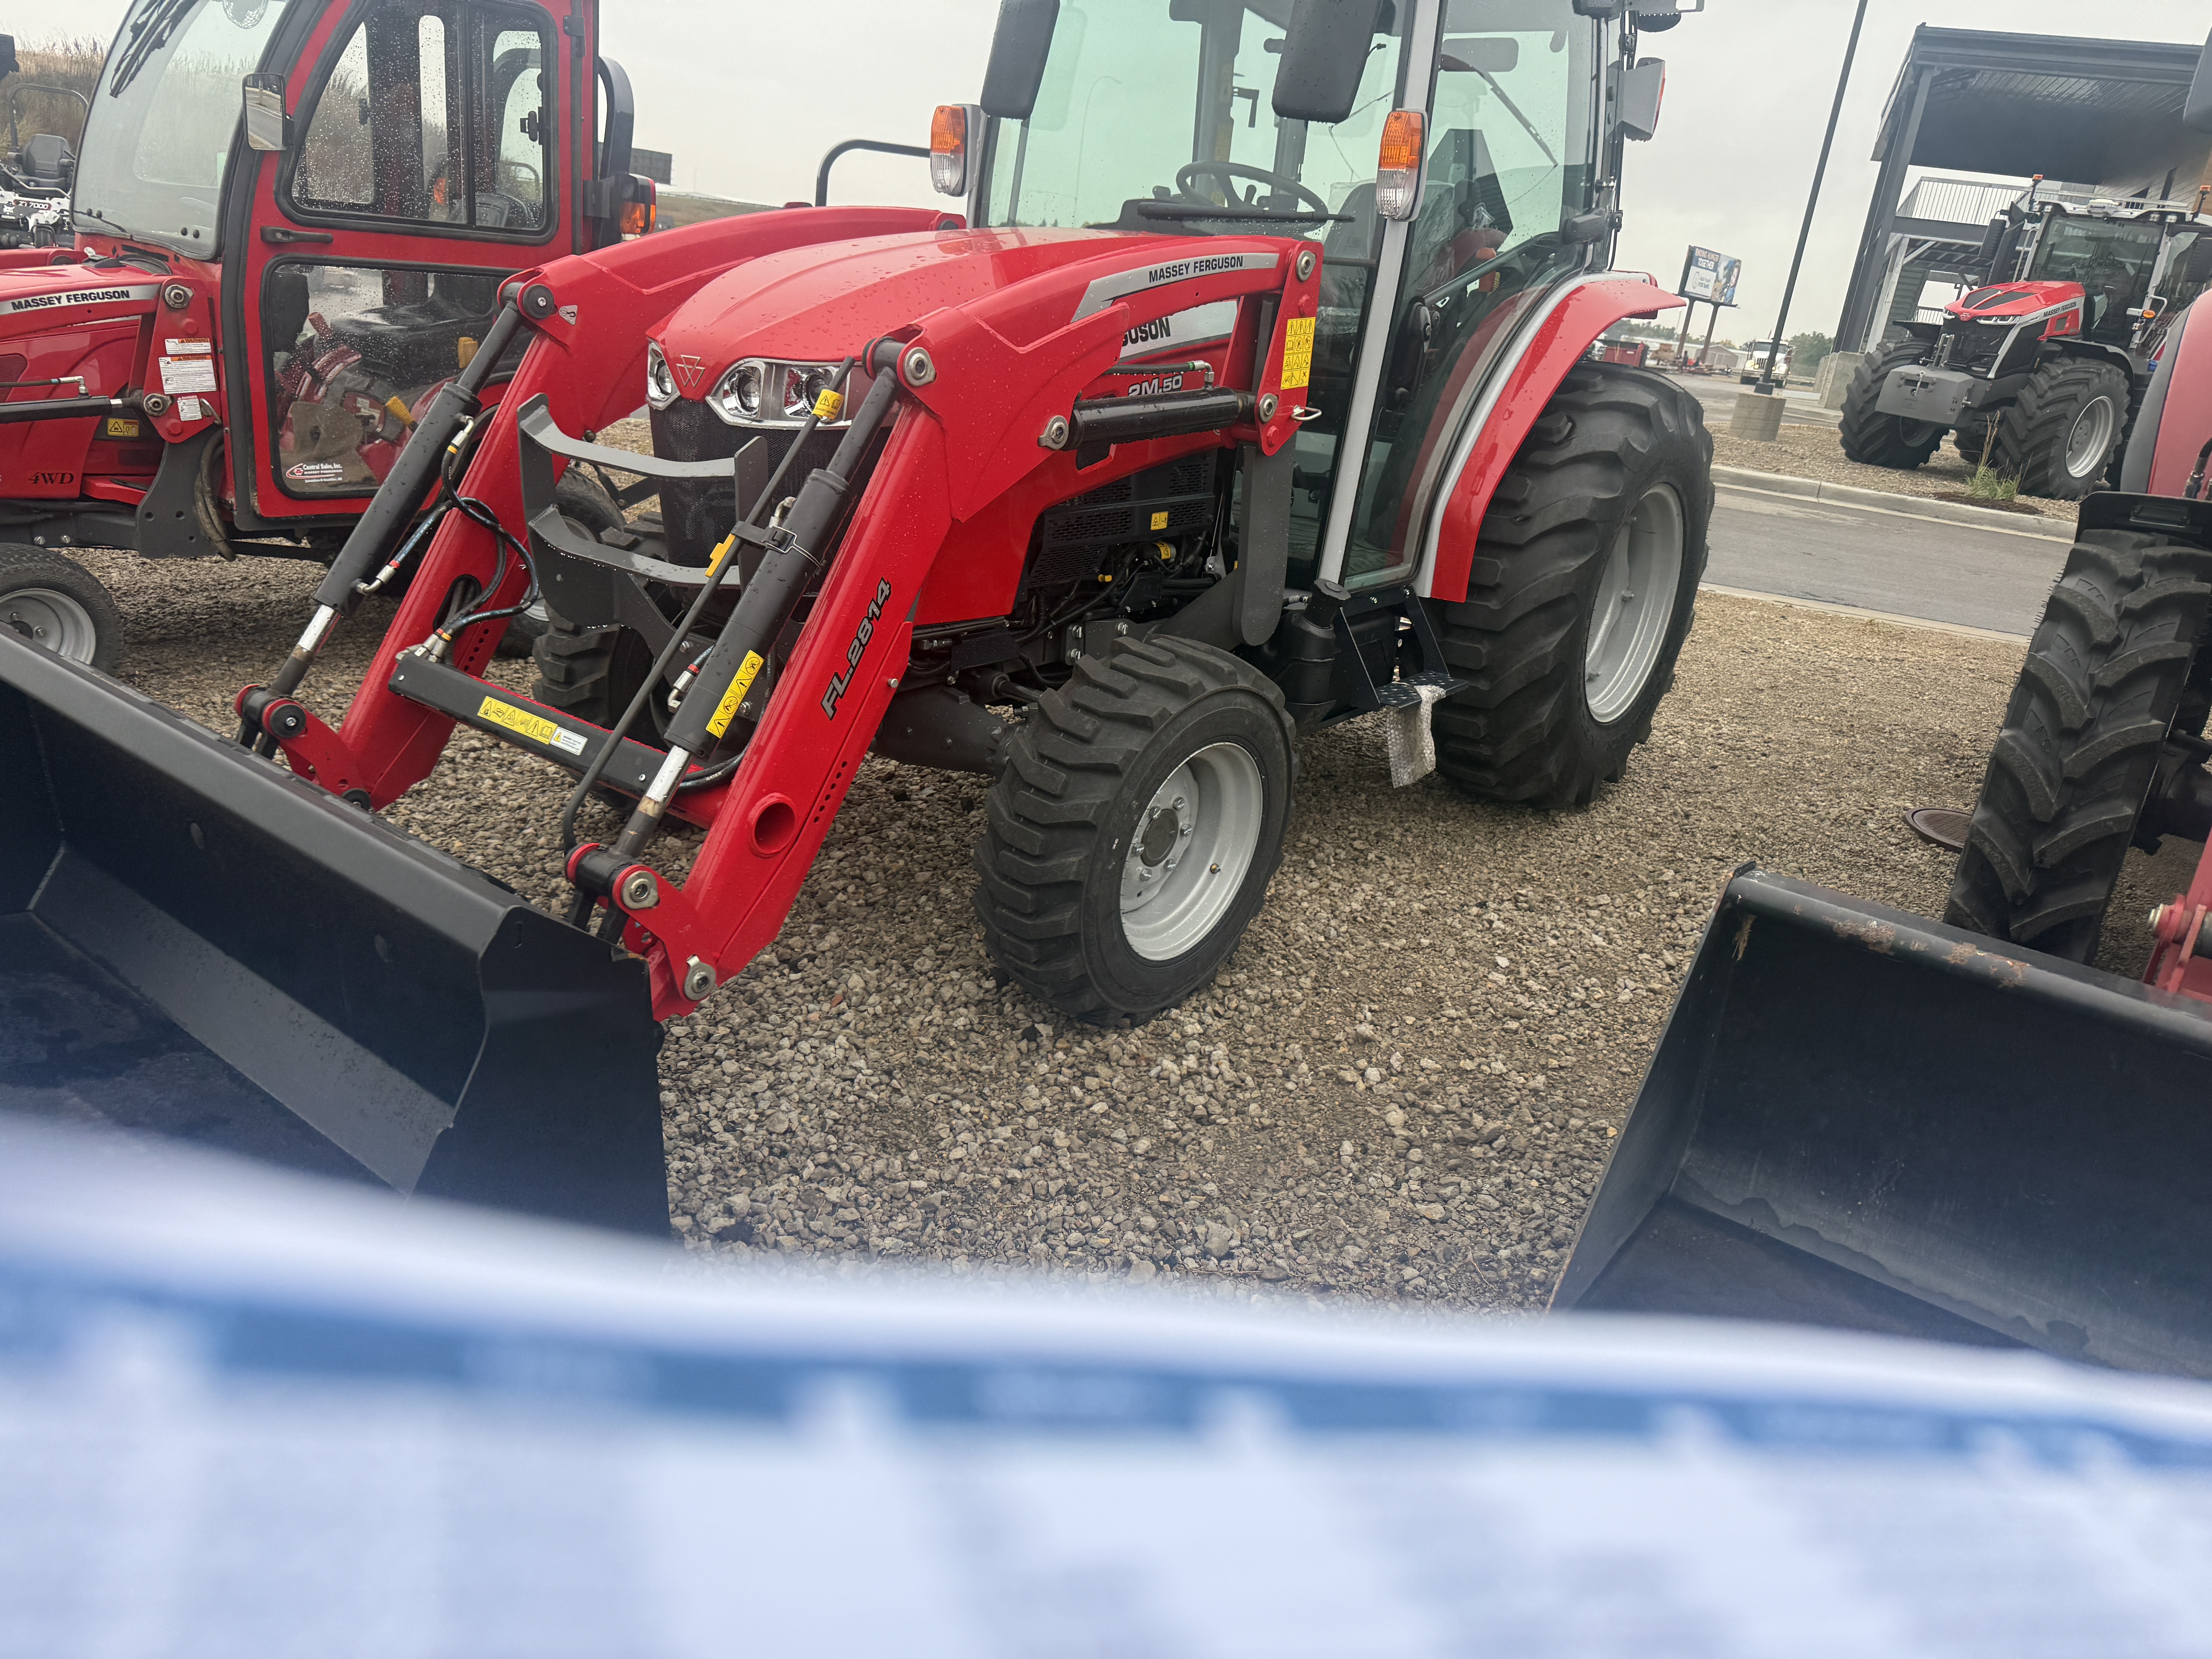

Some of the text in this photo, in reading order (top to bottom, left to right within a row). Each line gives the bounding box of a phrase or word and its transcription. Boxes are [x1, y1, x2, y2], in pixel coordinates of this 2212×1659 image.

[1149, 256, 1243, 283] MASSEY FERGUSON
[11, 290, 130, 310] MASSEY FERGUSON
[2044, 307, 2061, 317] MASSEY
[1128, 373, 1183, 397] 2M.50
[28, 472, 74, 484] 4WD
